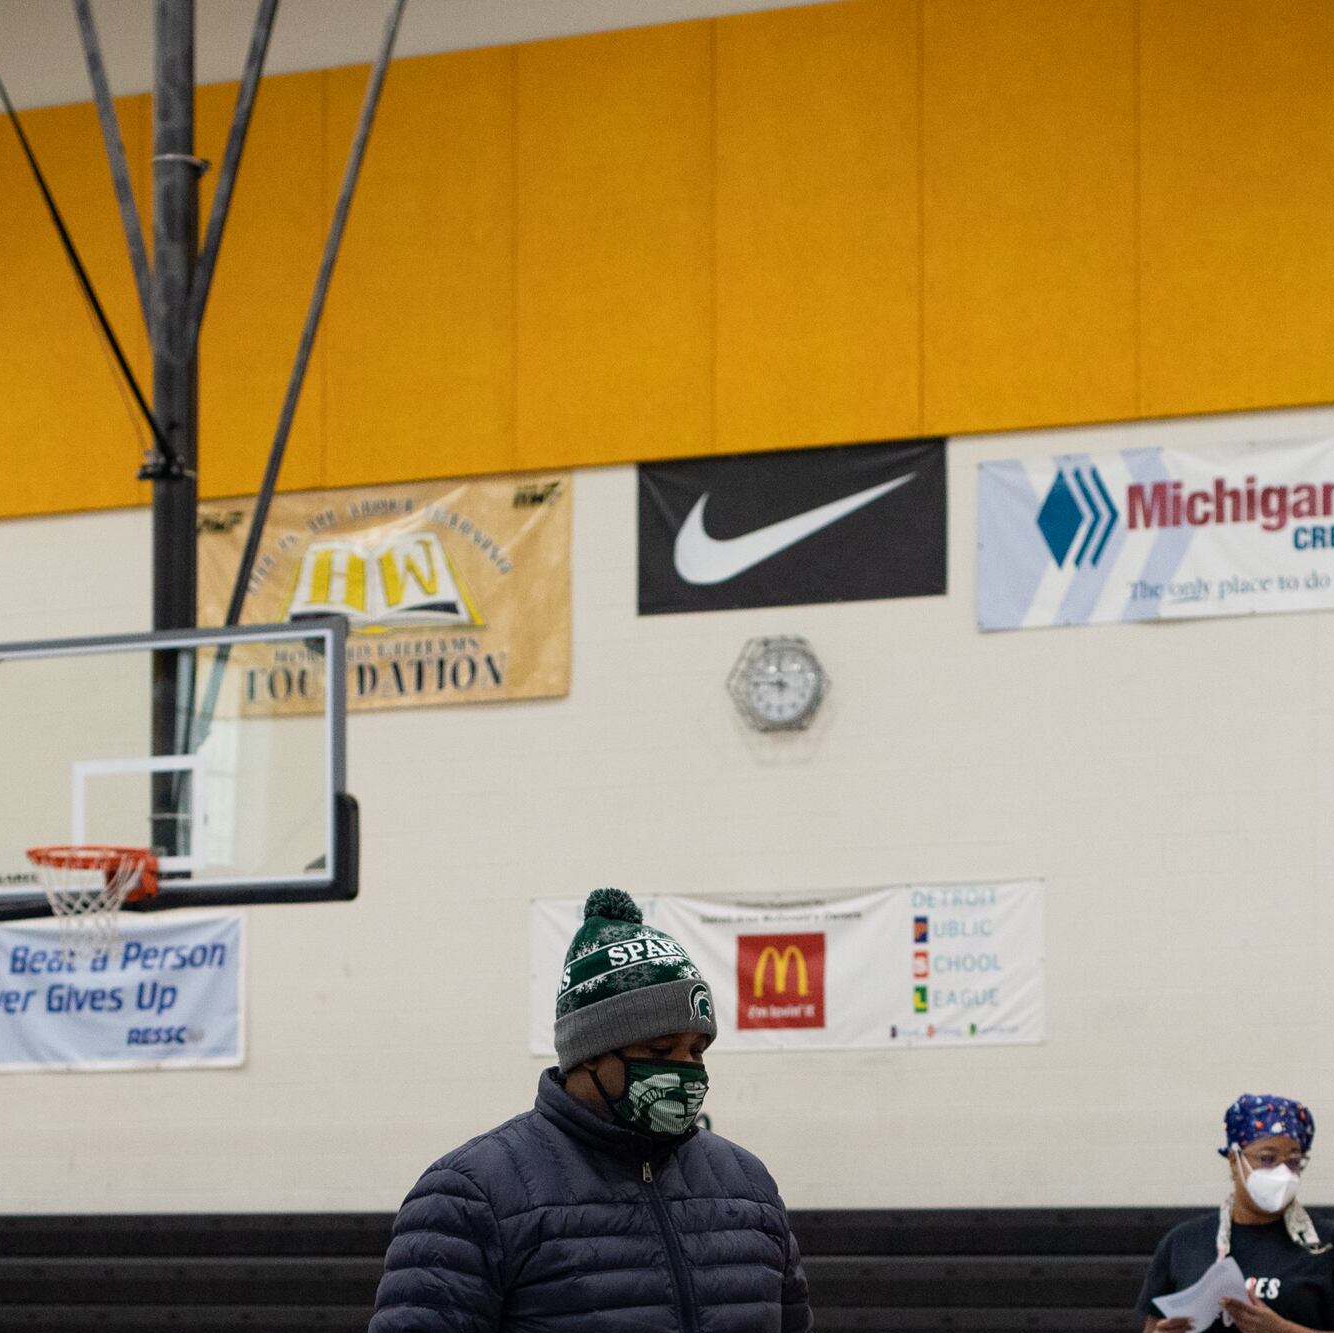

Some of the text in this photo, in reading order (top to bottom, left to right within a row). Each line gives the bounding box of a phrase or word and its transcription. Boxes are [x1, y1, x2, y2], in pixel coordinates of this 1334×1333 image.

[1129, 579, 1163, 600] The
[1218, 573, 1270, 598] place
[1277, 572, 1298, 591] to
[1305, 568, 1331, 590] do
[245, 652, 508, 704] FOUDATION
[911, 887, 997, 909] DETROIT
[120, 940, 227, 971] Person
[46, 983, 123, 1014] Gives
[135, 981, 178, 1015] Up
